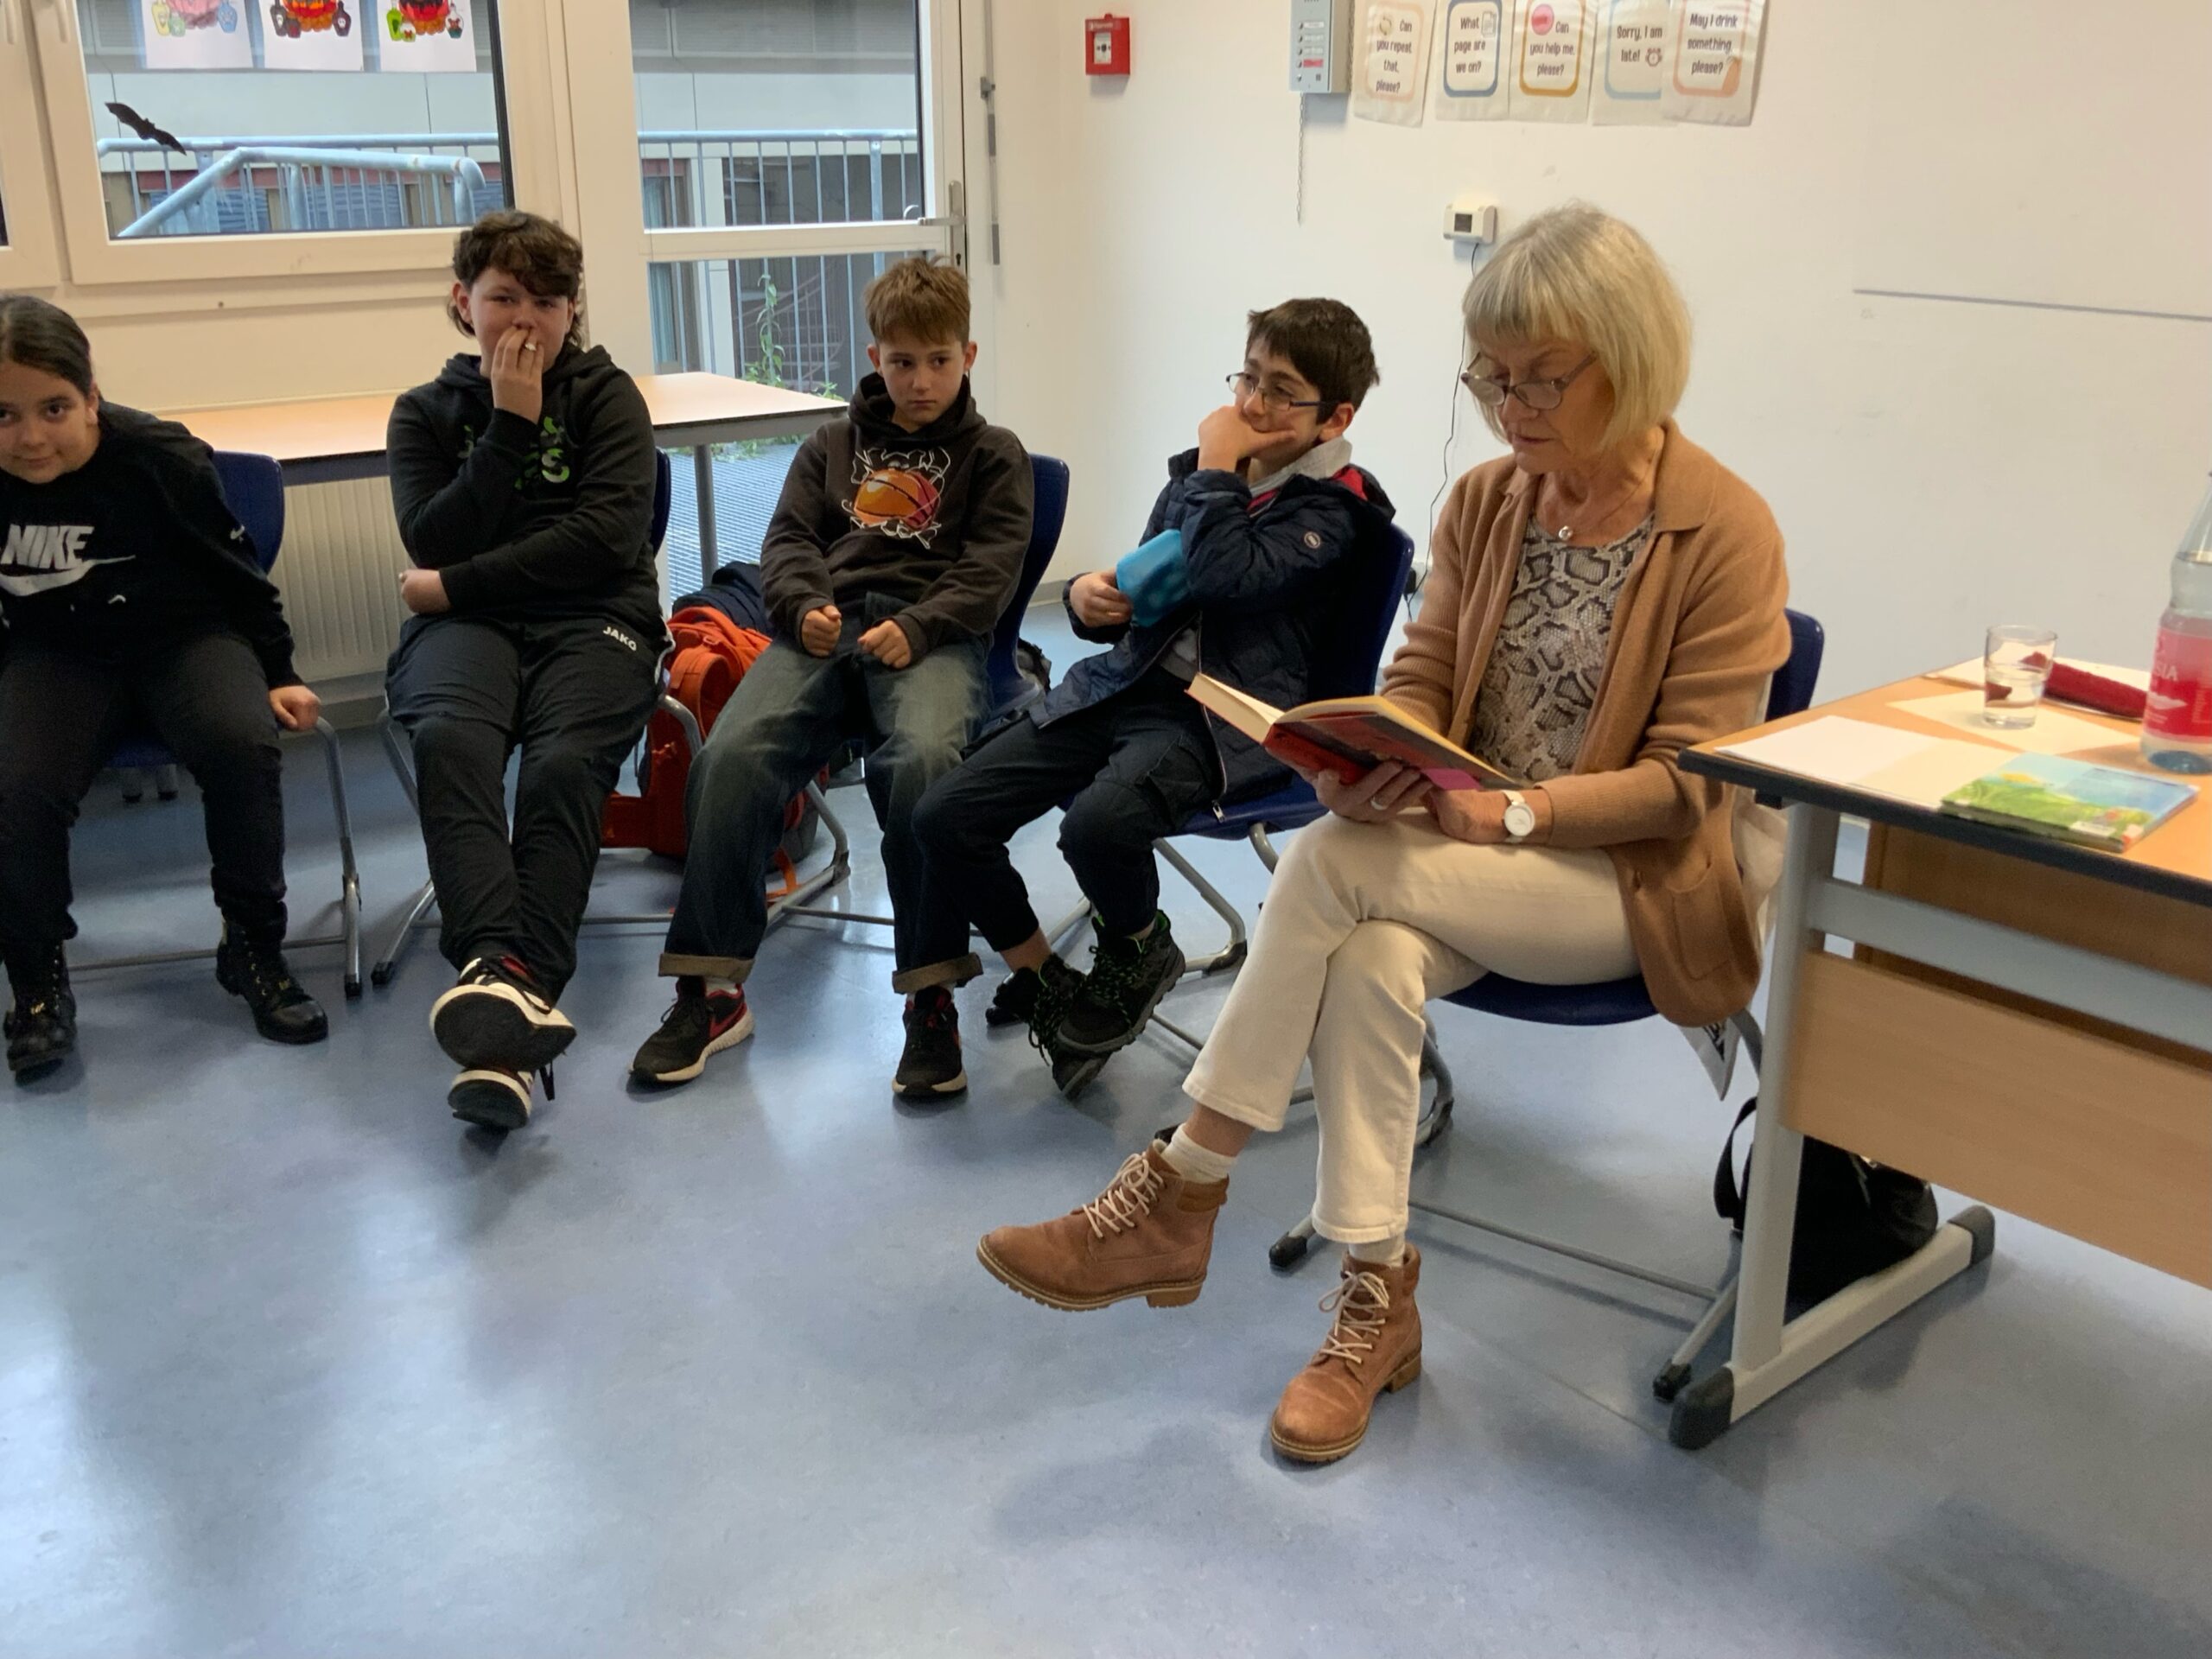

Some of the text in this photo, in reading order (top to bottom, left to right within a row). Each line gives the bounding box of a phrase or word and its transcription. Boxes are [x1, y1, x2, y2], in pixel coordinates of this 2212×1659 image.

[1460, 17, 1479, 29] What
[1555, 21, 1569, 34] Can
[1690, 13, 1738, 29] May I drink
[1649, 27, 1662, 39] am
[1390, 41, 1412, 54] repeat
[1454, 41, 1486, 54] page are
[1529, 43, 1544, 56] you
[1545, 41, 1561, 57] help
[1621, 48, 1640, 62] late!
[1456, 60, 1482, 73] we on?
[1537, 63, 1565, 77] please?
[1691, 60, 1724, 75] please?
[0, 524, 95, 569] NIKE
[602, 626, 637, 652] JAKO
